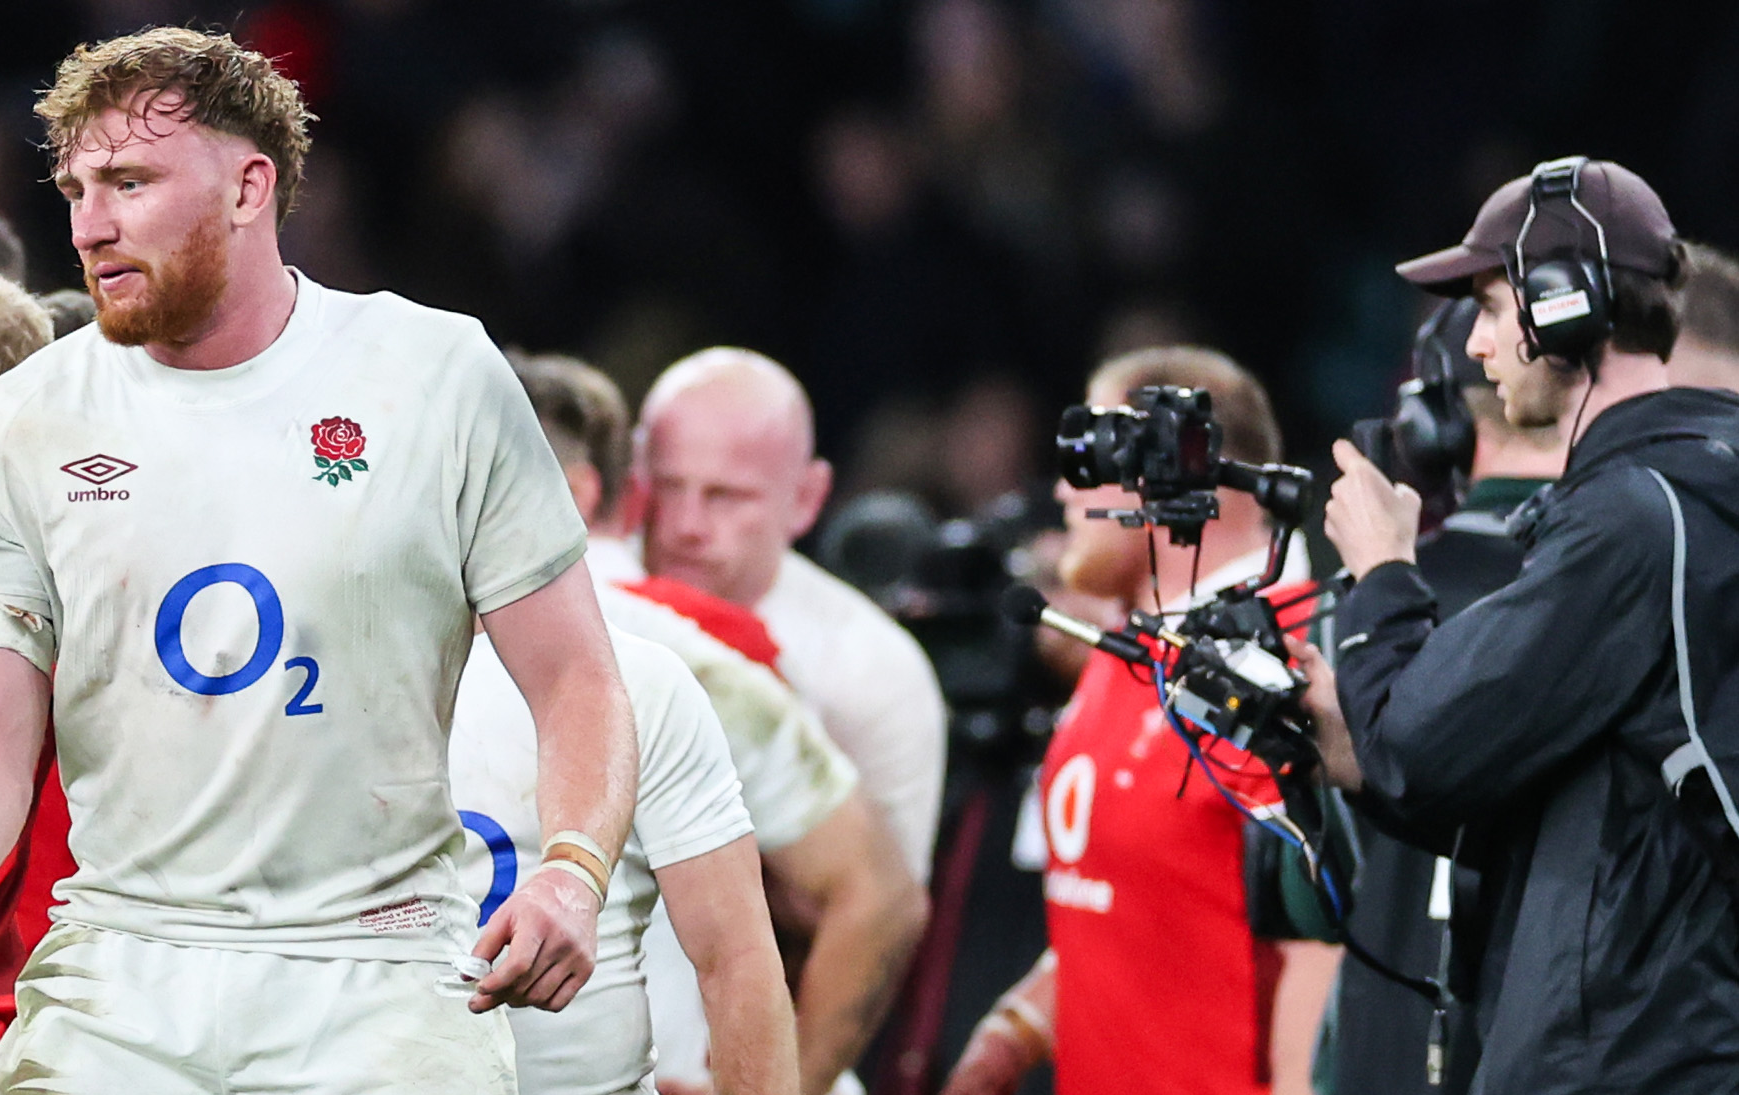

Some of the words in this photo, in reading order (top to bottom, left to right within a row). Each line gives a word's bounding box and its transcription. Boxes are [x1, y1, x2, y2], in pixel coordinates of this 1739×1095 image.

[67, 487, 130, 502] umbro
[358, 914, 394, 923] England
[403, 906, 427, 915] Wales
